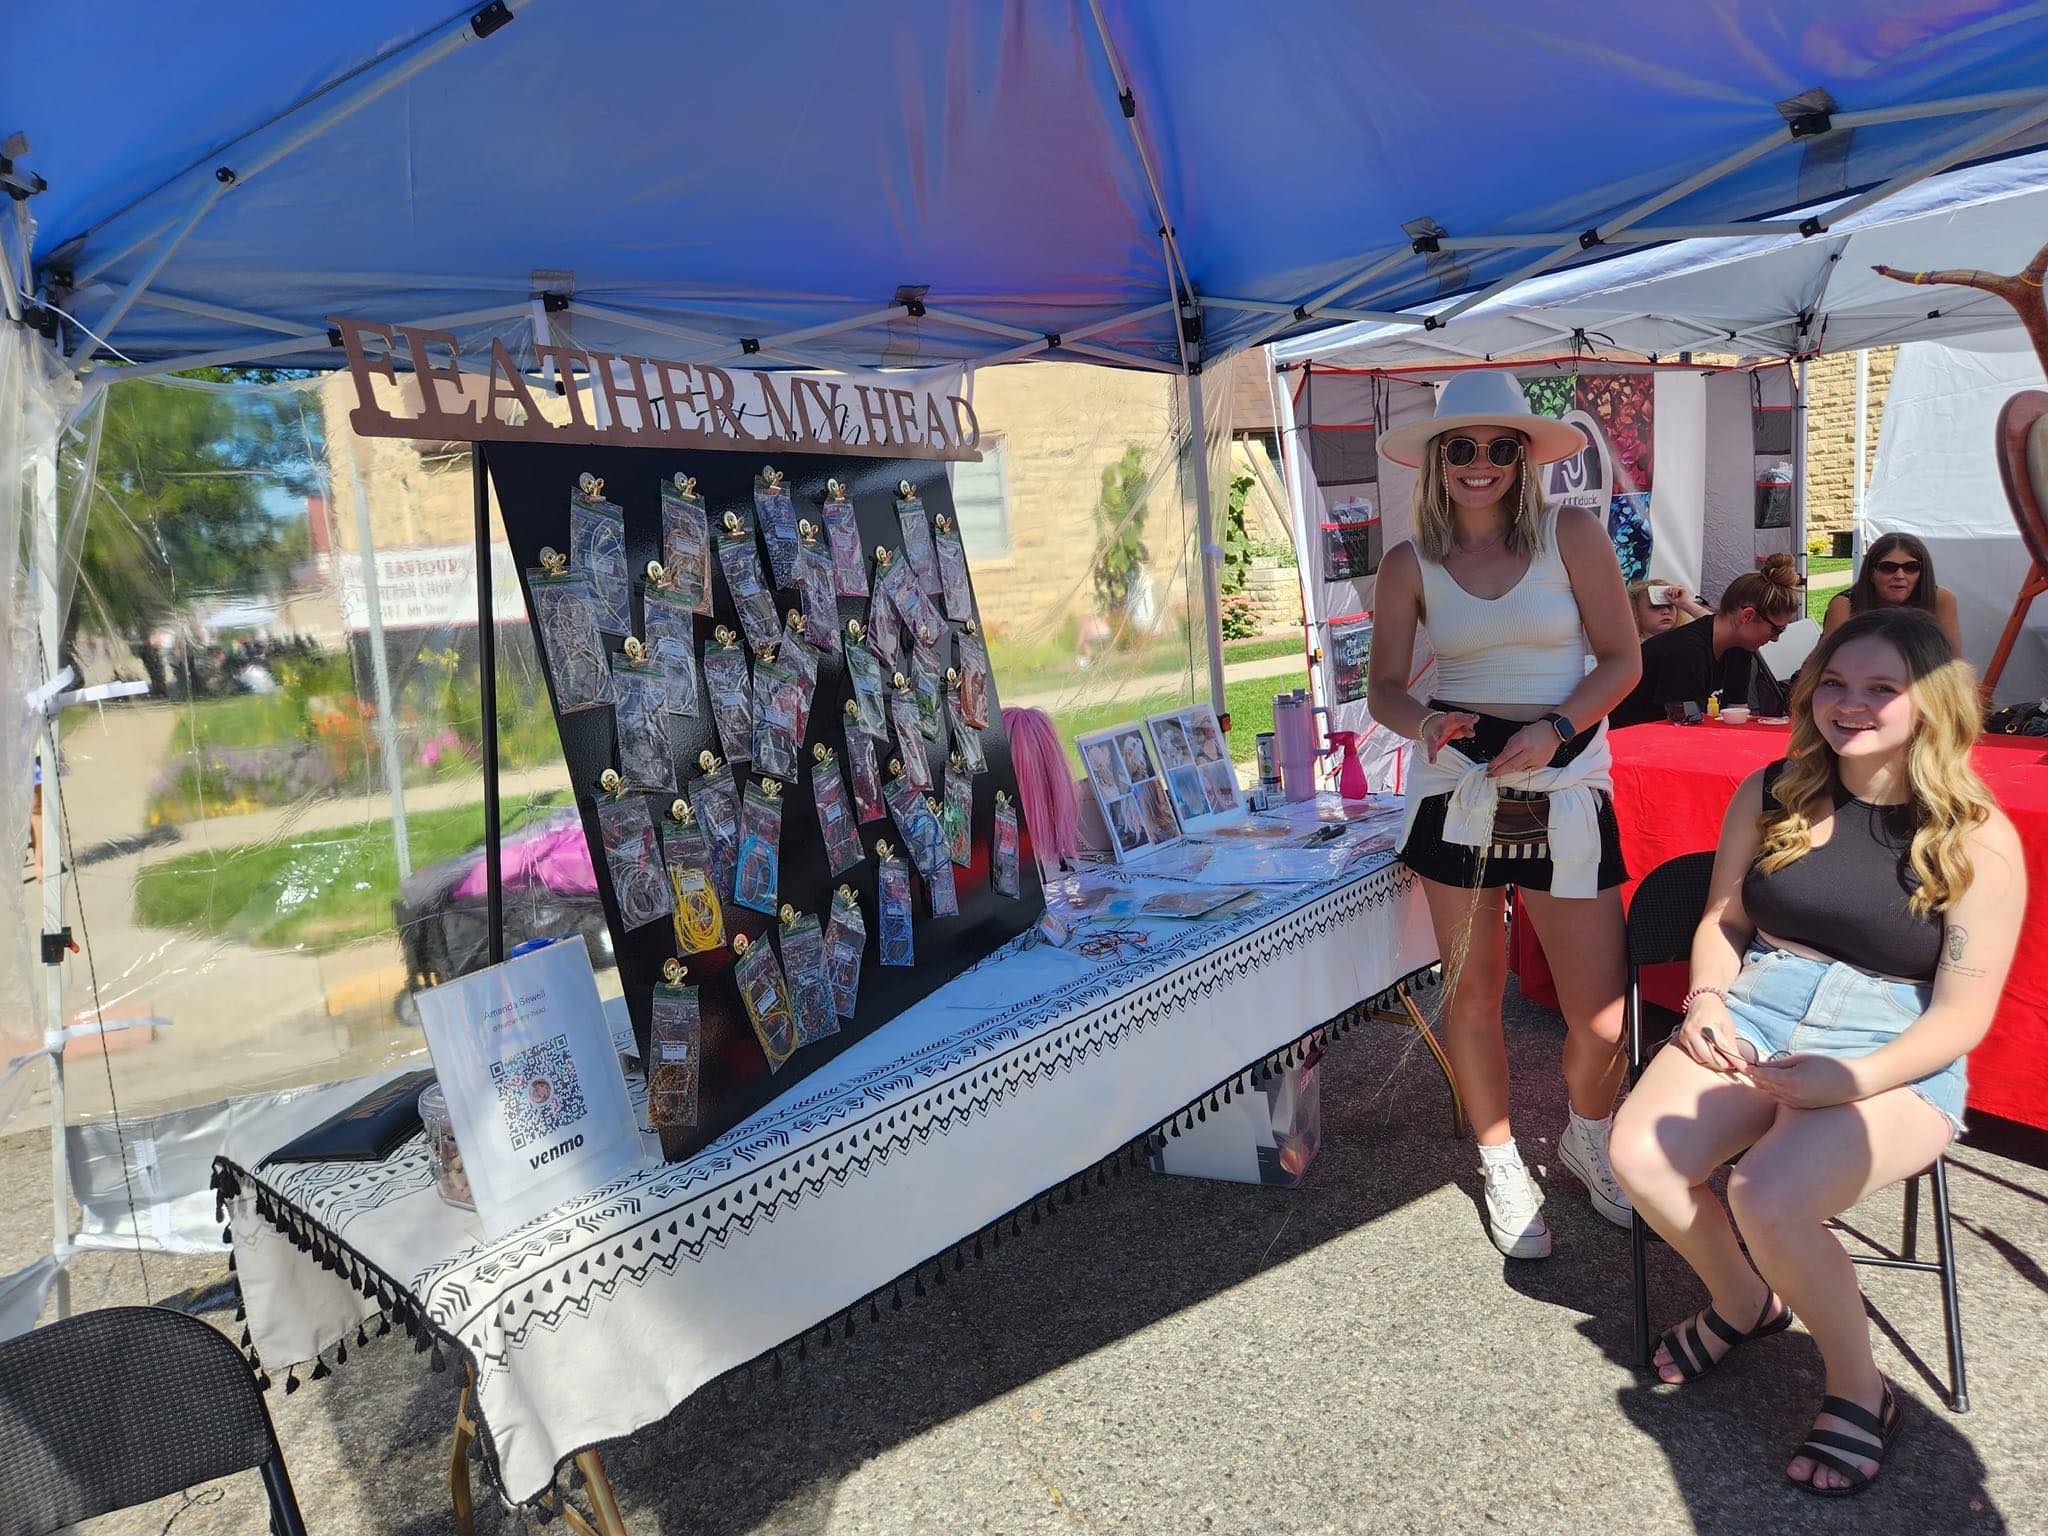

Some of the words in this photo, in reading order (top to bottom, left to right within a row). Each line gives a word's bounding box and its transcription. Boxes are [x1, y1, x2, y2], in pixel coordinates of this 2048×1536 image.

[326, 316, 748, 439] FEATHER
[753, 372, 842, 444] MY
[854, 384, 980, 450] HEAD
[529, 1134, 584, 1170] venmo
